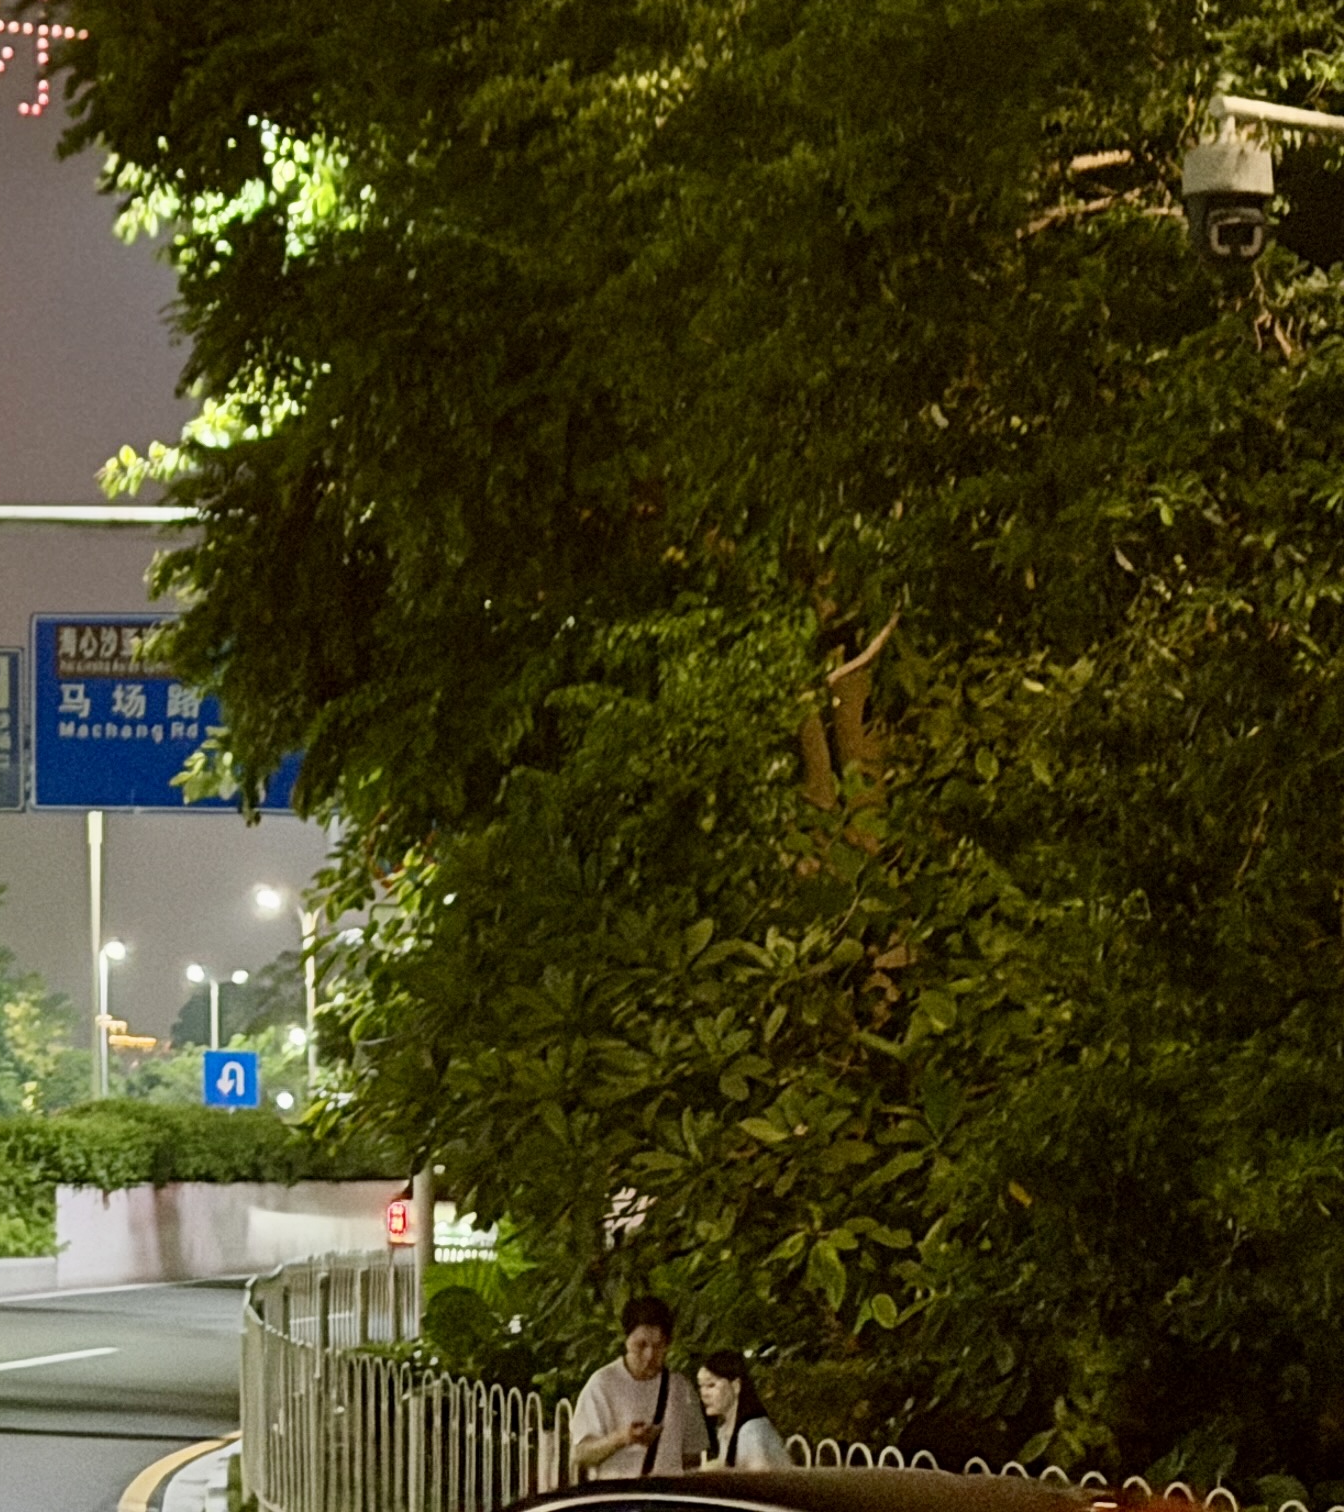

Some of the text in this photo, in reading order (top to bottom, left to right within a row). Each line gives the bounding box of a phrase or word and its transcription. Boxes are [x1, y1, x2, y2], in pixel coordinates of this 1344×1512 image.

[59, 683, 202, 718] 马场路
[59, 721, 199, 744] Machang Rd
